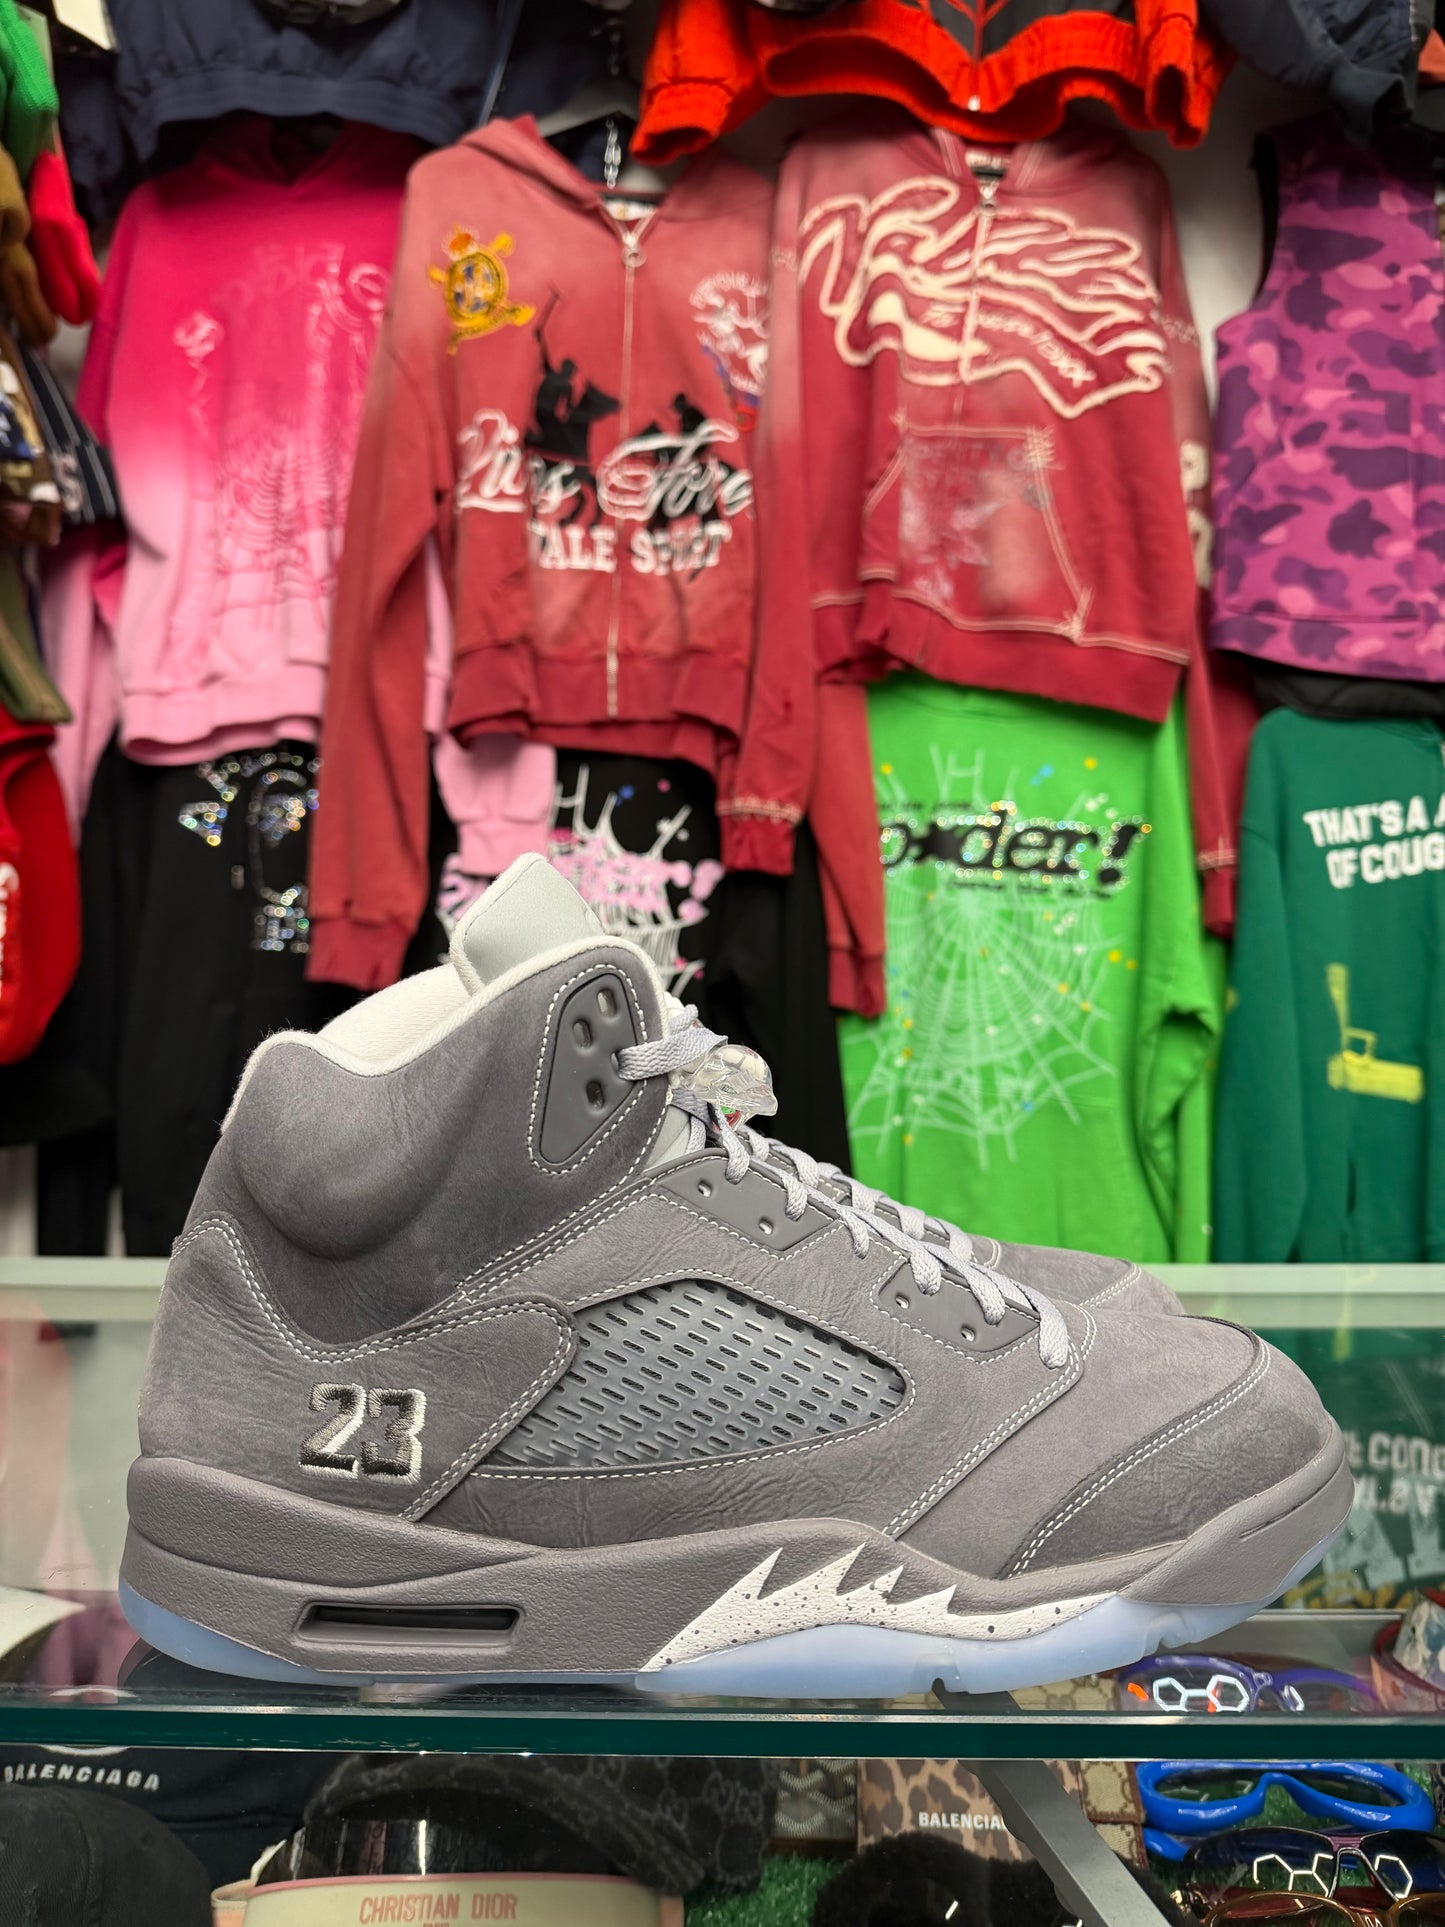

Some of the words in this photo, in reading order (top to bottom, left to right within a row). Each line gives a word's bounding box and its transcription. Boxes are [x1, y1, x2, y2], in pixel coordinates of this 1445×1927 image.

[1302, 800, 1404, 848] THAT'S
[1406, 794, 1430, 833] A
[1325, 847, 1358, 890] OF
[298, 1382, 427, 1485] 23
[4, 1763, 160, 1792] BALENCIAGA
[918, 1811, 1004, 1831] BALENCIA
[359, 1893, 461, 1925] CHRISTIAN
[471, 1892, 518, 1920] DIOR
